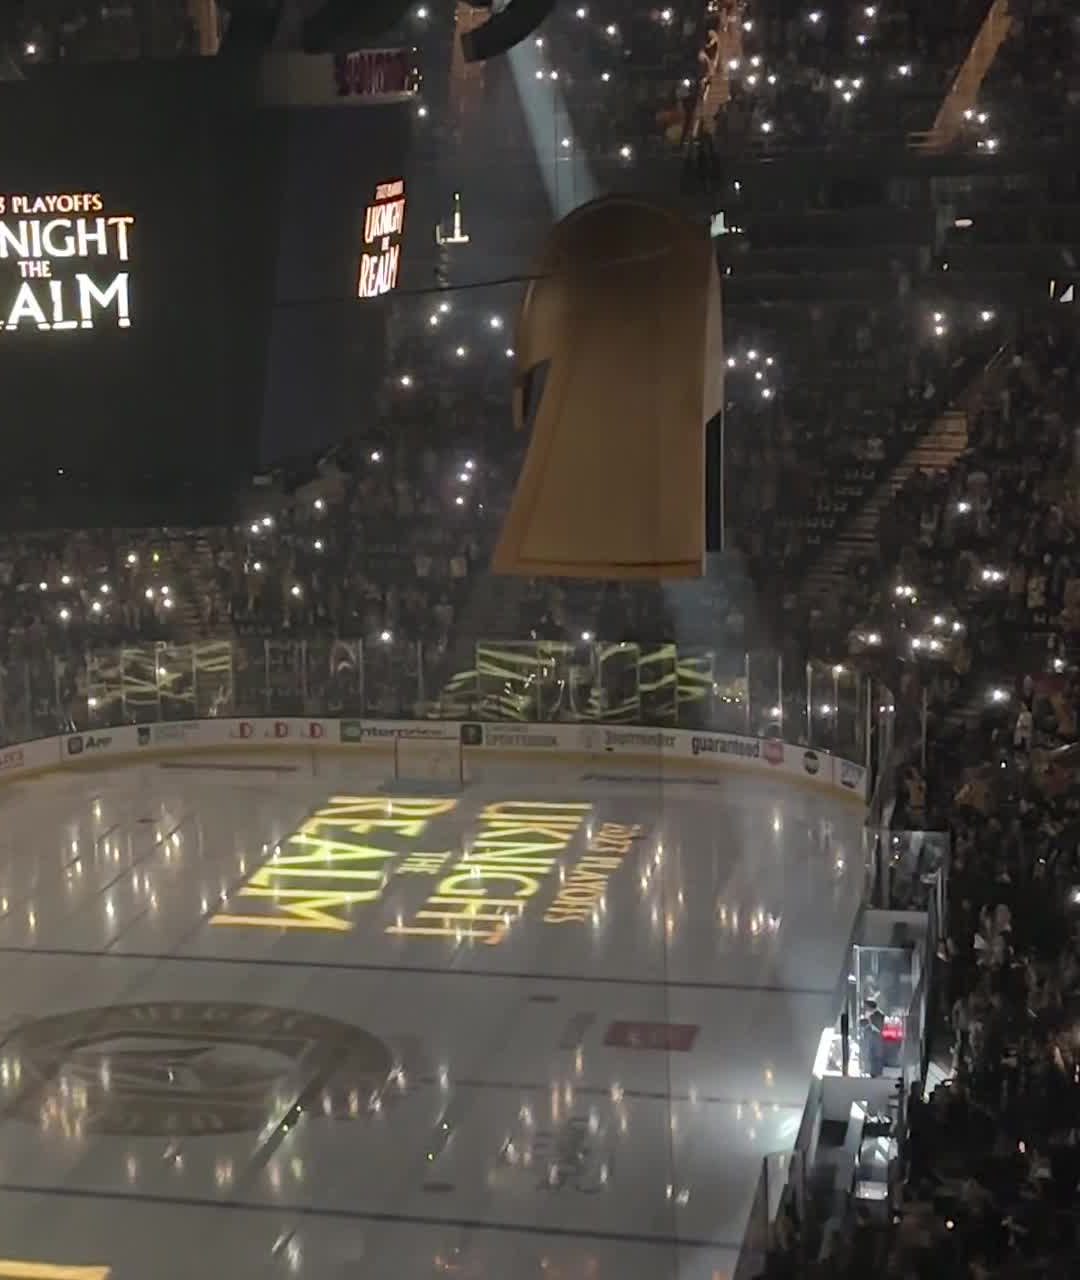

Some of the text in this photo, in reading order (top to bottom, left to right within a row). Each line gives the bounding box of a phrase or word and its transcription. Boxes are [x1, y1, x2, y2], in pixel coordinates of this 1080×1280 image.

[12, 193, 103, 214] PLAYOFFS
[17, 260, 52, 278] THE
[358, 244, 400, 297] REALM
[208, 796, 457, 931] REALM
[384, 801, 592, 945] UKNIGHT
[394, 851, 451, 874] THE
[543, 856, 623, 923] PLAYOFFS
